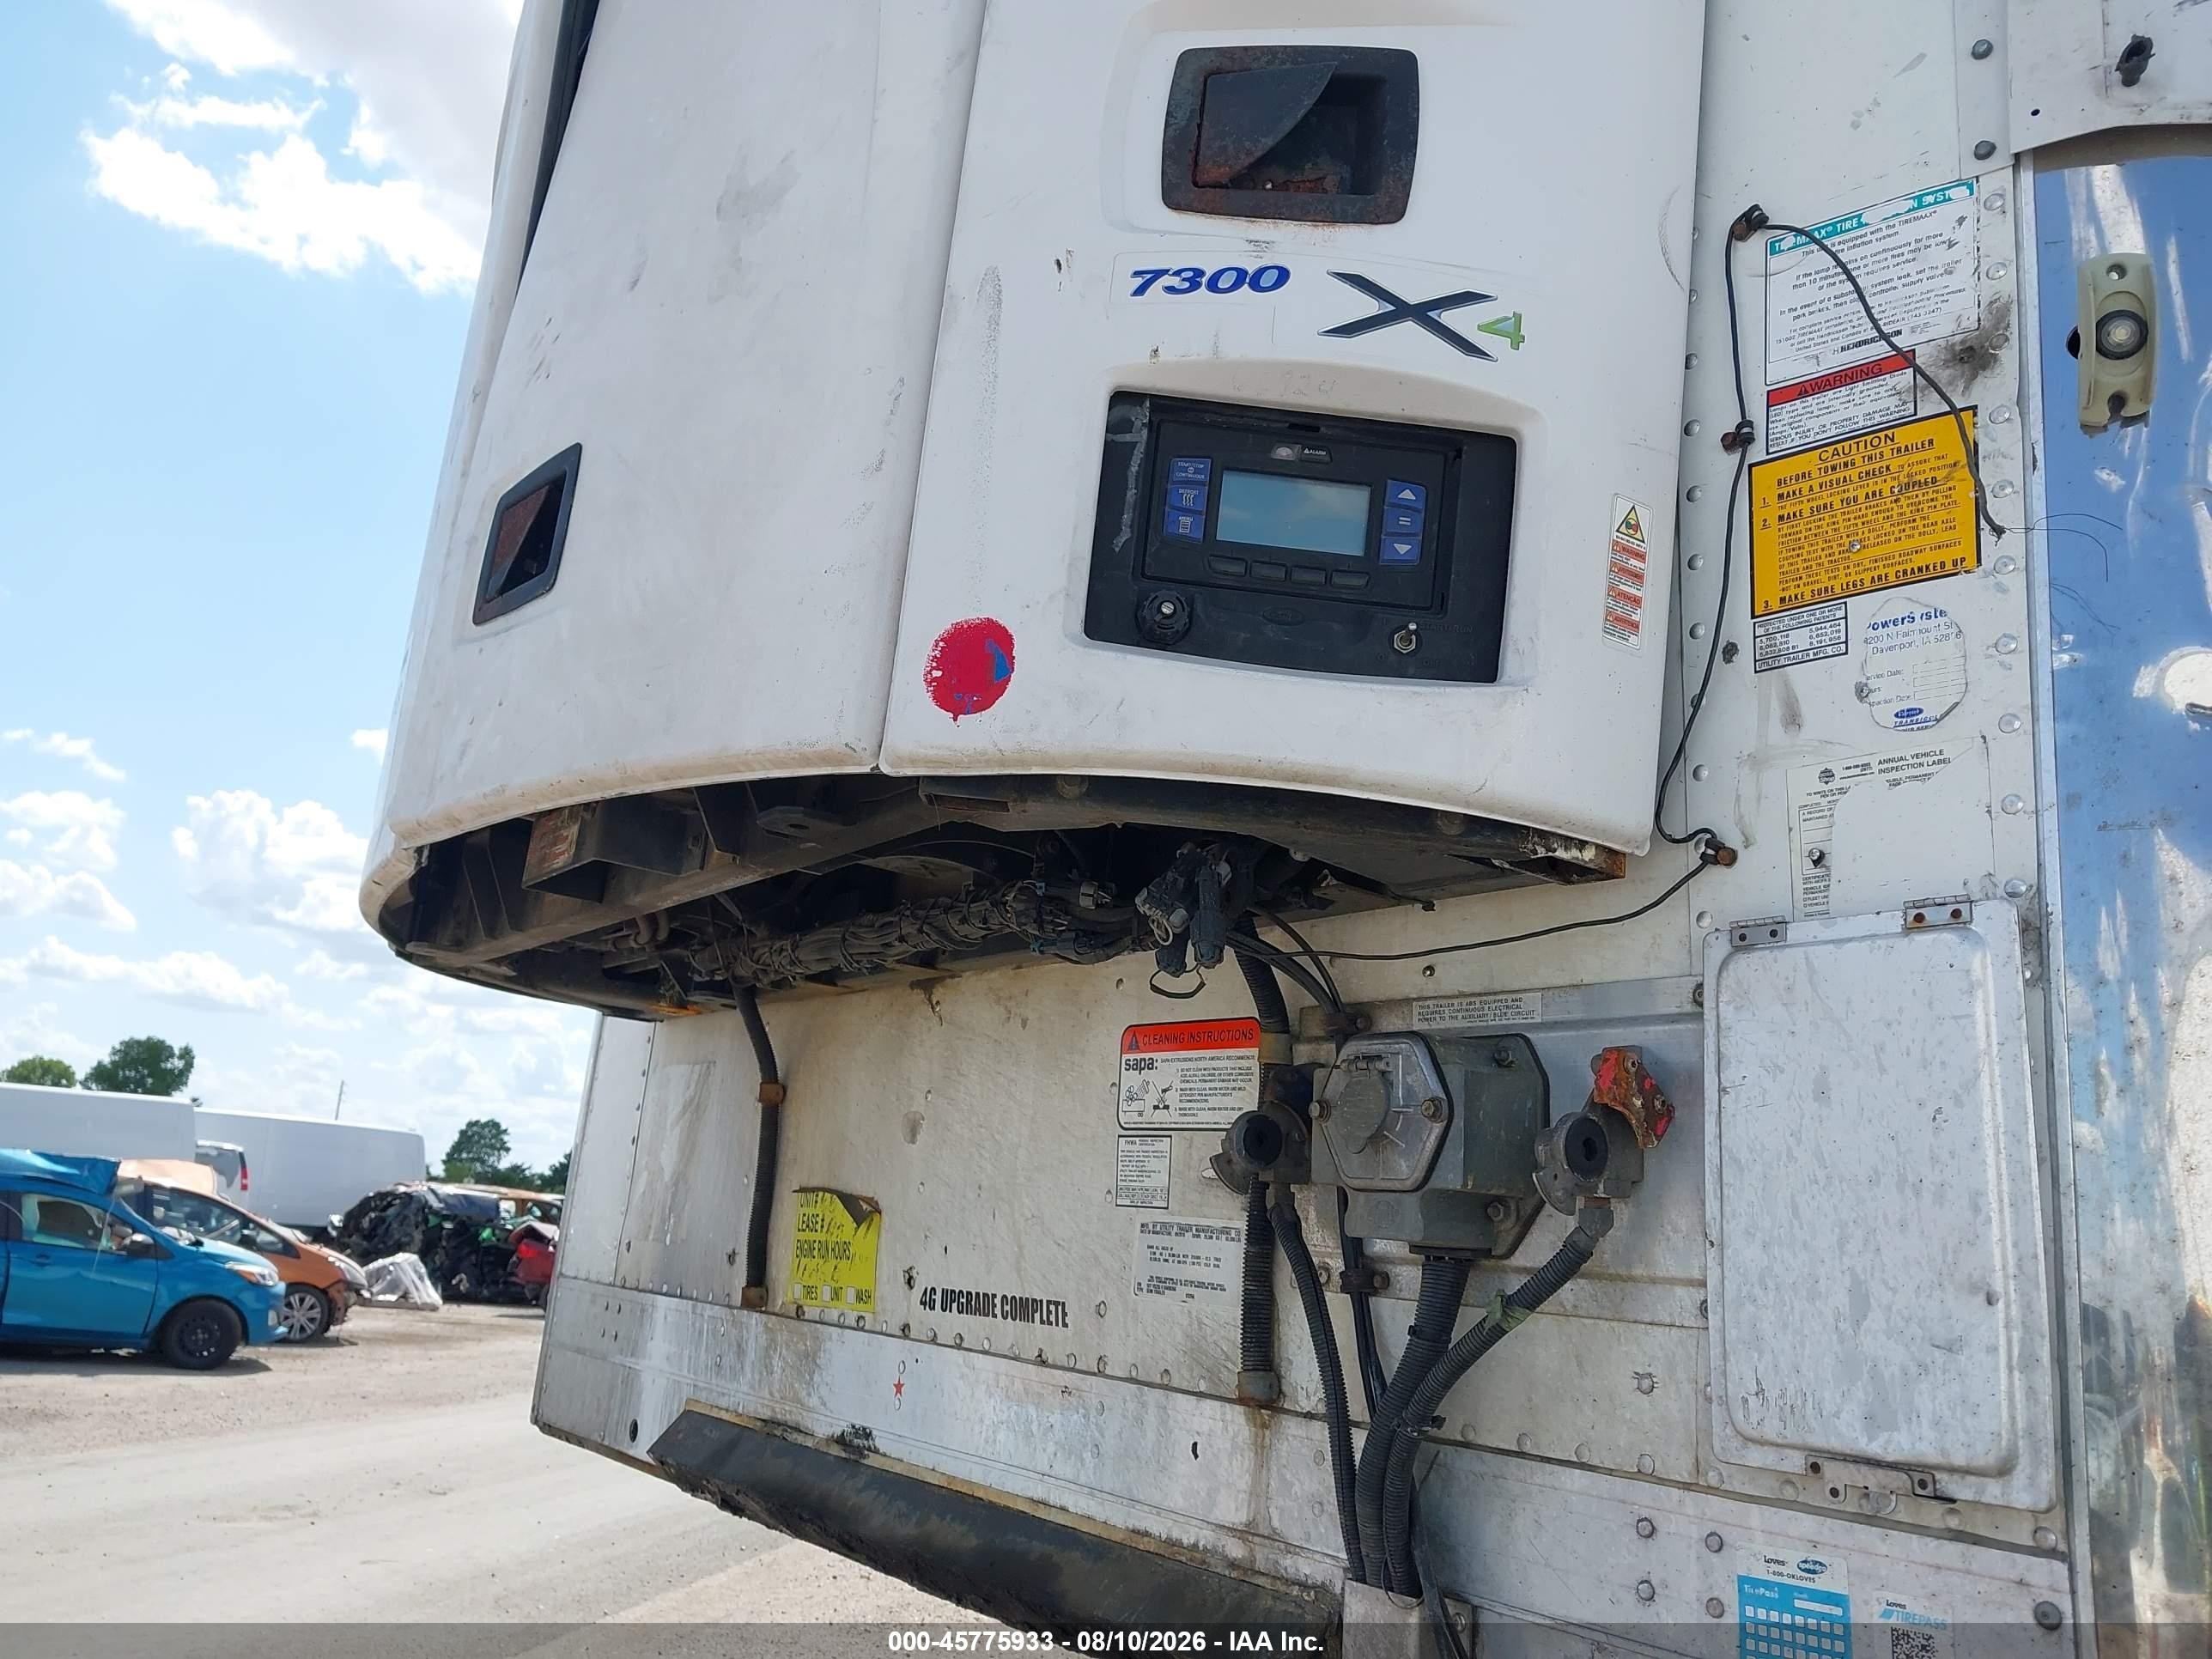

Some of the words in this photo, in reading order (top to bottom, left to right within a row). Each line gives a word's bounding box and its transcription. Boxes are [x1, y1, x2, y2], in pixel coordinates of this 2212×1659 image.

[1837, 217, 1858, 232] TIRE
[1802, 246, 1814, 256] This
[1838, 231, 1868, 246] equipped
[1869, 226, 1883, 236] with
[1846, 238, 1872, 252] inflation
[1792, 280, 1806, 289] than
[1907, 246, 1922, 256] may
[1802, 270, 1812, 279] the
[1814, 264, 1830, 276] lamp
[1832, 257, 1856, 270] reains
[1860, 253, 1868, 262] on
[1870, 240, 1911, 258] continuously
[1914, 236, 1923, 246] for
[1130, 263, 1291, 297] 7300
[1317, 269, 1498, 362] X
[1477, 311, 1526, 351] 4
[1809, 362, 1881, 392] WARNING
[1830, 414, 1858, 427] PROPERTY
[1863, 405, 1891, 417] DAMAGE
[1818, 431, 1895, 462] CAUTION
[1777, 469, 1813, 487] BEFORE
[1817, 458, 1856, 476] TOWING
[1861, 450, 1884, 465] THIS
[1889, 437, 1934, 458] TRAILER
[1762, 495, 1769, 505] 1.
[1778, 486, 1803, 501] MAKE
[1808, 483, 1814, 493] A
[1818, 472, 1853, 490] VISUAL
[1857, 463, 1891, 480] CHECK
[1906, 457, 1930, 468] ASSURE
[1934, 452, 1948, 461] THAT
[1761, 516, 1771, 527] 2.
[1778, 507, 1804, 523] MAKE
[1808, 500, 1834, 515] SURE
[1839, 494, 1858, 507] YOU
[1864, 488, 1884, 501] ARE
[1889, 474, 1936, 495] COUPLED
[1763, 599, 1771, 609] 3.
[1779, 591, 1805, 605] MAKE
[1810, 584, 1835, 599] SURE
[1840, 578, 1864, 592] LEGS
[1869, 572, 1889, 586] ARE
[1894, 560, 1945, 580] CRANKED
[1951, 555, 1966, 567] UP
[1757, 617, 1785, 629] PROTECTED
[1787, 613, 1804, 622] UNDER
[1782, 617, 1812, 629] FOLLOWING
[1814, 612, 1836, 622] PATENTS
[1887, 632, 1893, 641] N
[1758, 658, 1780, 668] UTILITY
[1784, 652, 1810, 663] TRAILER
[1812, 647, 1829, 657] MFG.
[1831, 645, 1844, 653] CO.
[1877, 754, 1909, 767] ANNUAL
[1910, 747, 1944, 761] VEHICLE
[1878, 760, 1924, 775] INSPECTION
[1926, 755, 1951, 767] LABEL
[1417, 1008, 1445, 1017] REQUIRES
[1448, 1006, 1484, 1014] CONTINUOUS
[1488, 1003, 1522, 1012] ELECTRICAL
[1142, 1031, 1184, 1046] CLEANING
[1187, 1027, 1254, 1043] INSTRUCTIONS
[798, 1213, 819, 1233] LEASE
[1194, 1226, 1231, 1236] MANUFACTURING
[796, 1239, 817, 1260] ENGINE
[817, 1239, 830, 1261] RUN
[830, 1240, 851, 1261] HOURS
[802, 1285, 818, 1301] TIRES
[830, 1286, 843, 1302] UNIT
[855, 1288, 872, 1306] WASH
[920, 1287, 937, 1312] 4G
[940, 1289, 998, 1319] UPGRADE
[1000, 1295, 1069, 1328] COMPLETE
[1895, 1611, 1947, 1631] TIREPASS
